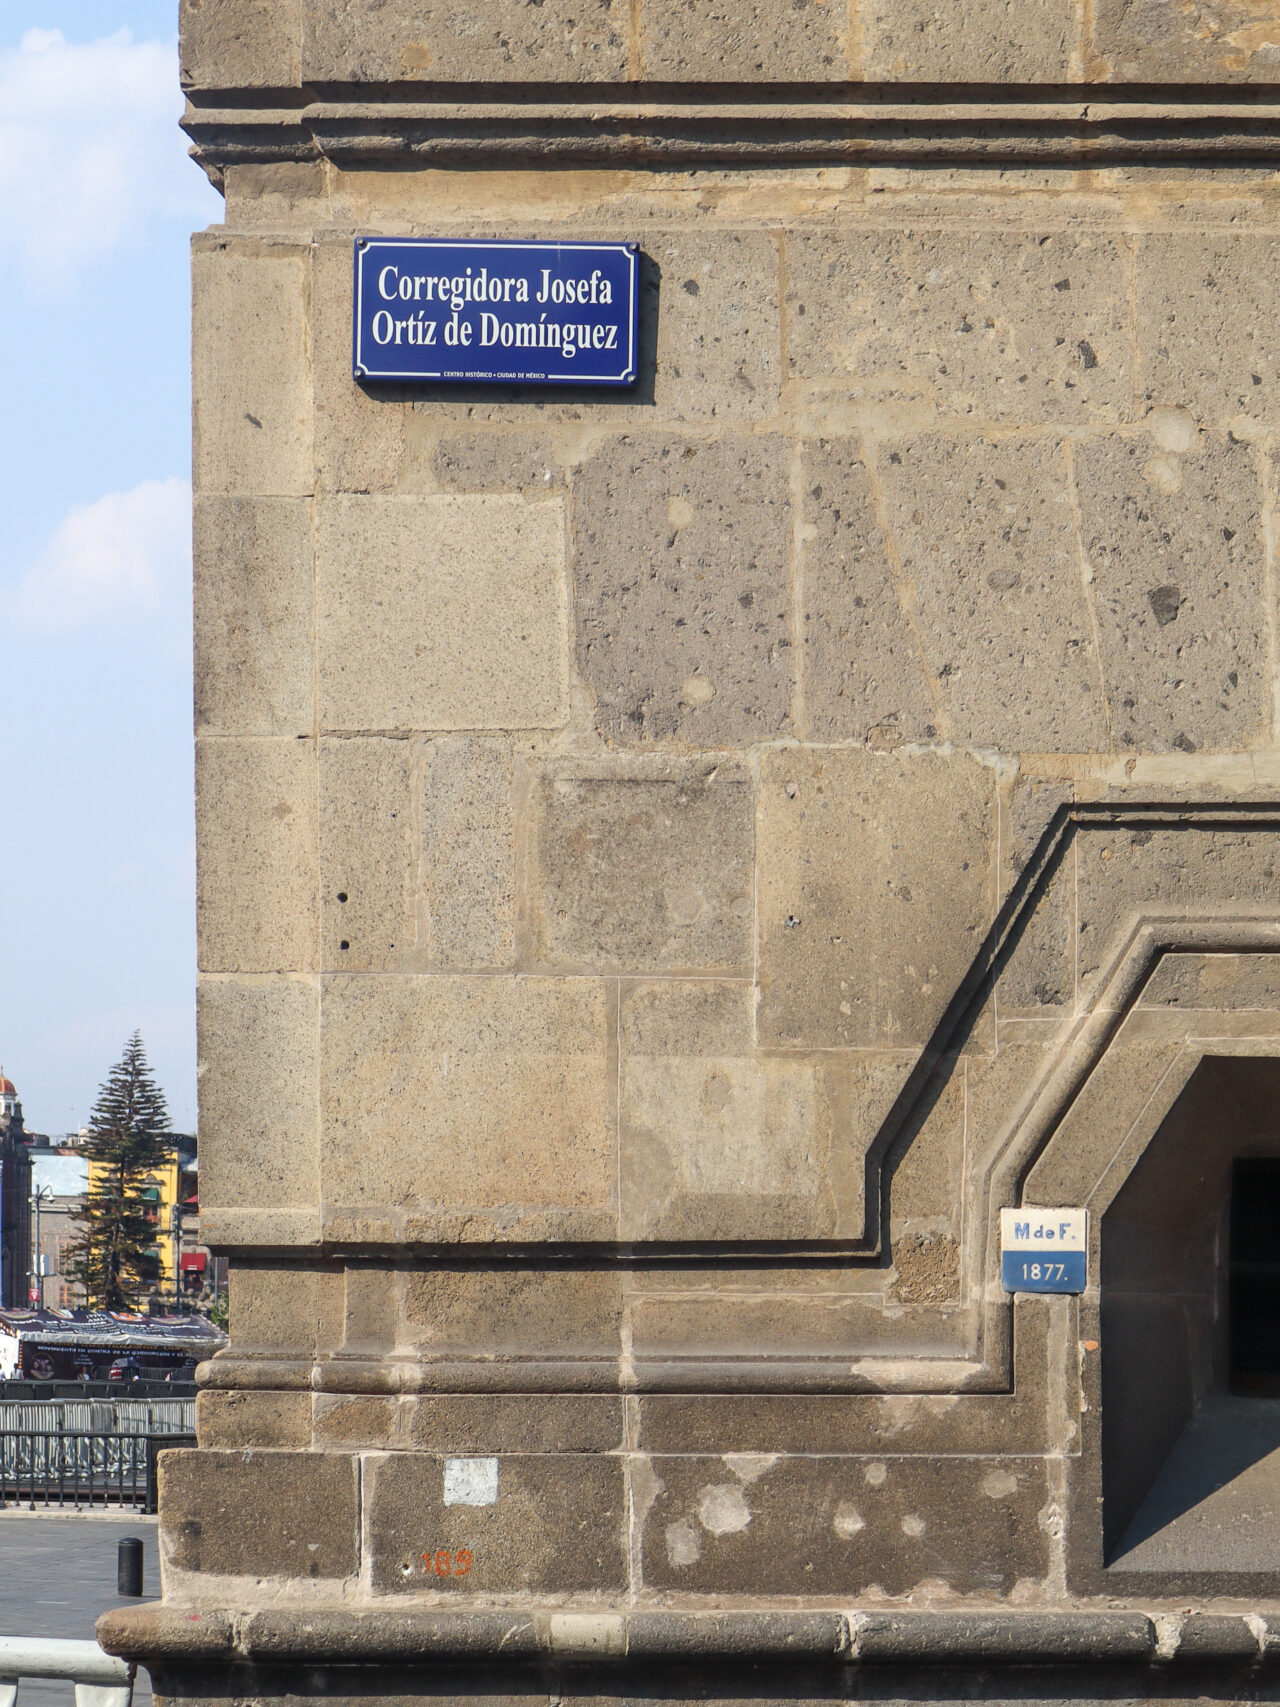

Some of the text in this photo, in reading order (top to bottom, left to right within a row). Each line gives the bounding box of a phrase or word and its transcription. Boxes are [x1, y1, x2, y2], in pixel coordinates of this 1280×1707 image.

[378, 265, 613, 311] Corregidora Josefa
[372, 310, 618, 358] Ortíz de Domínguez
[1022, 1263, 1068, 1281] 1877.
[420, 1550, 473, 1577] 189
